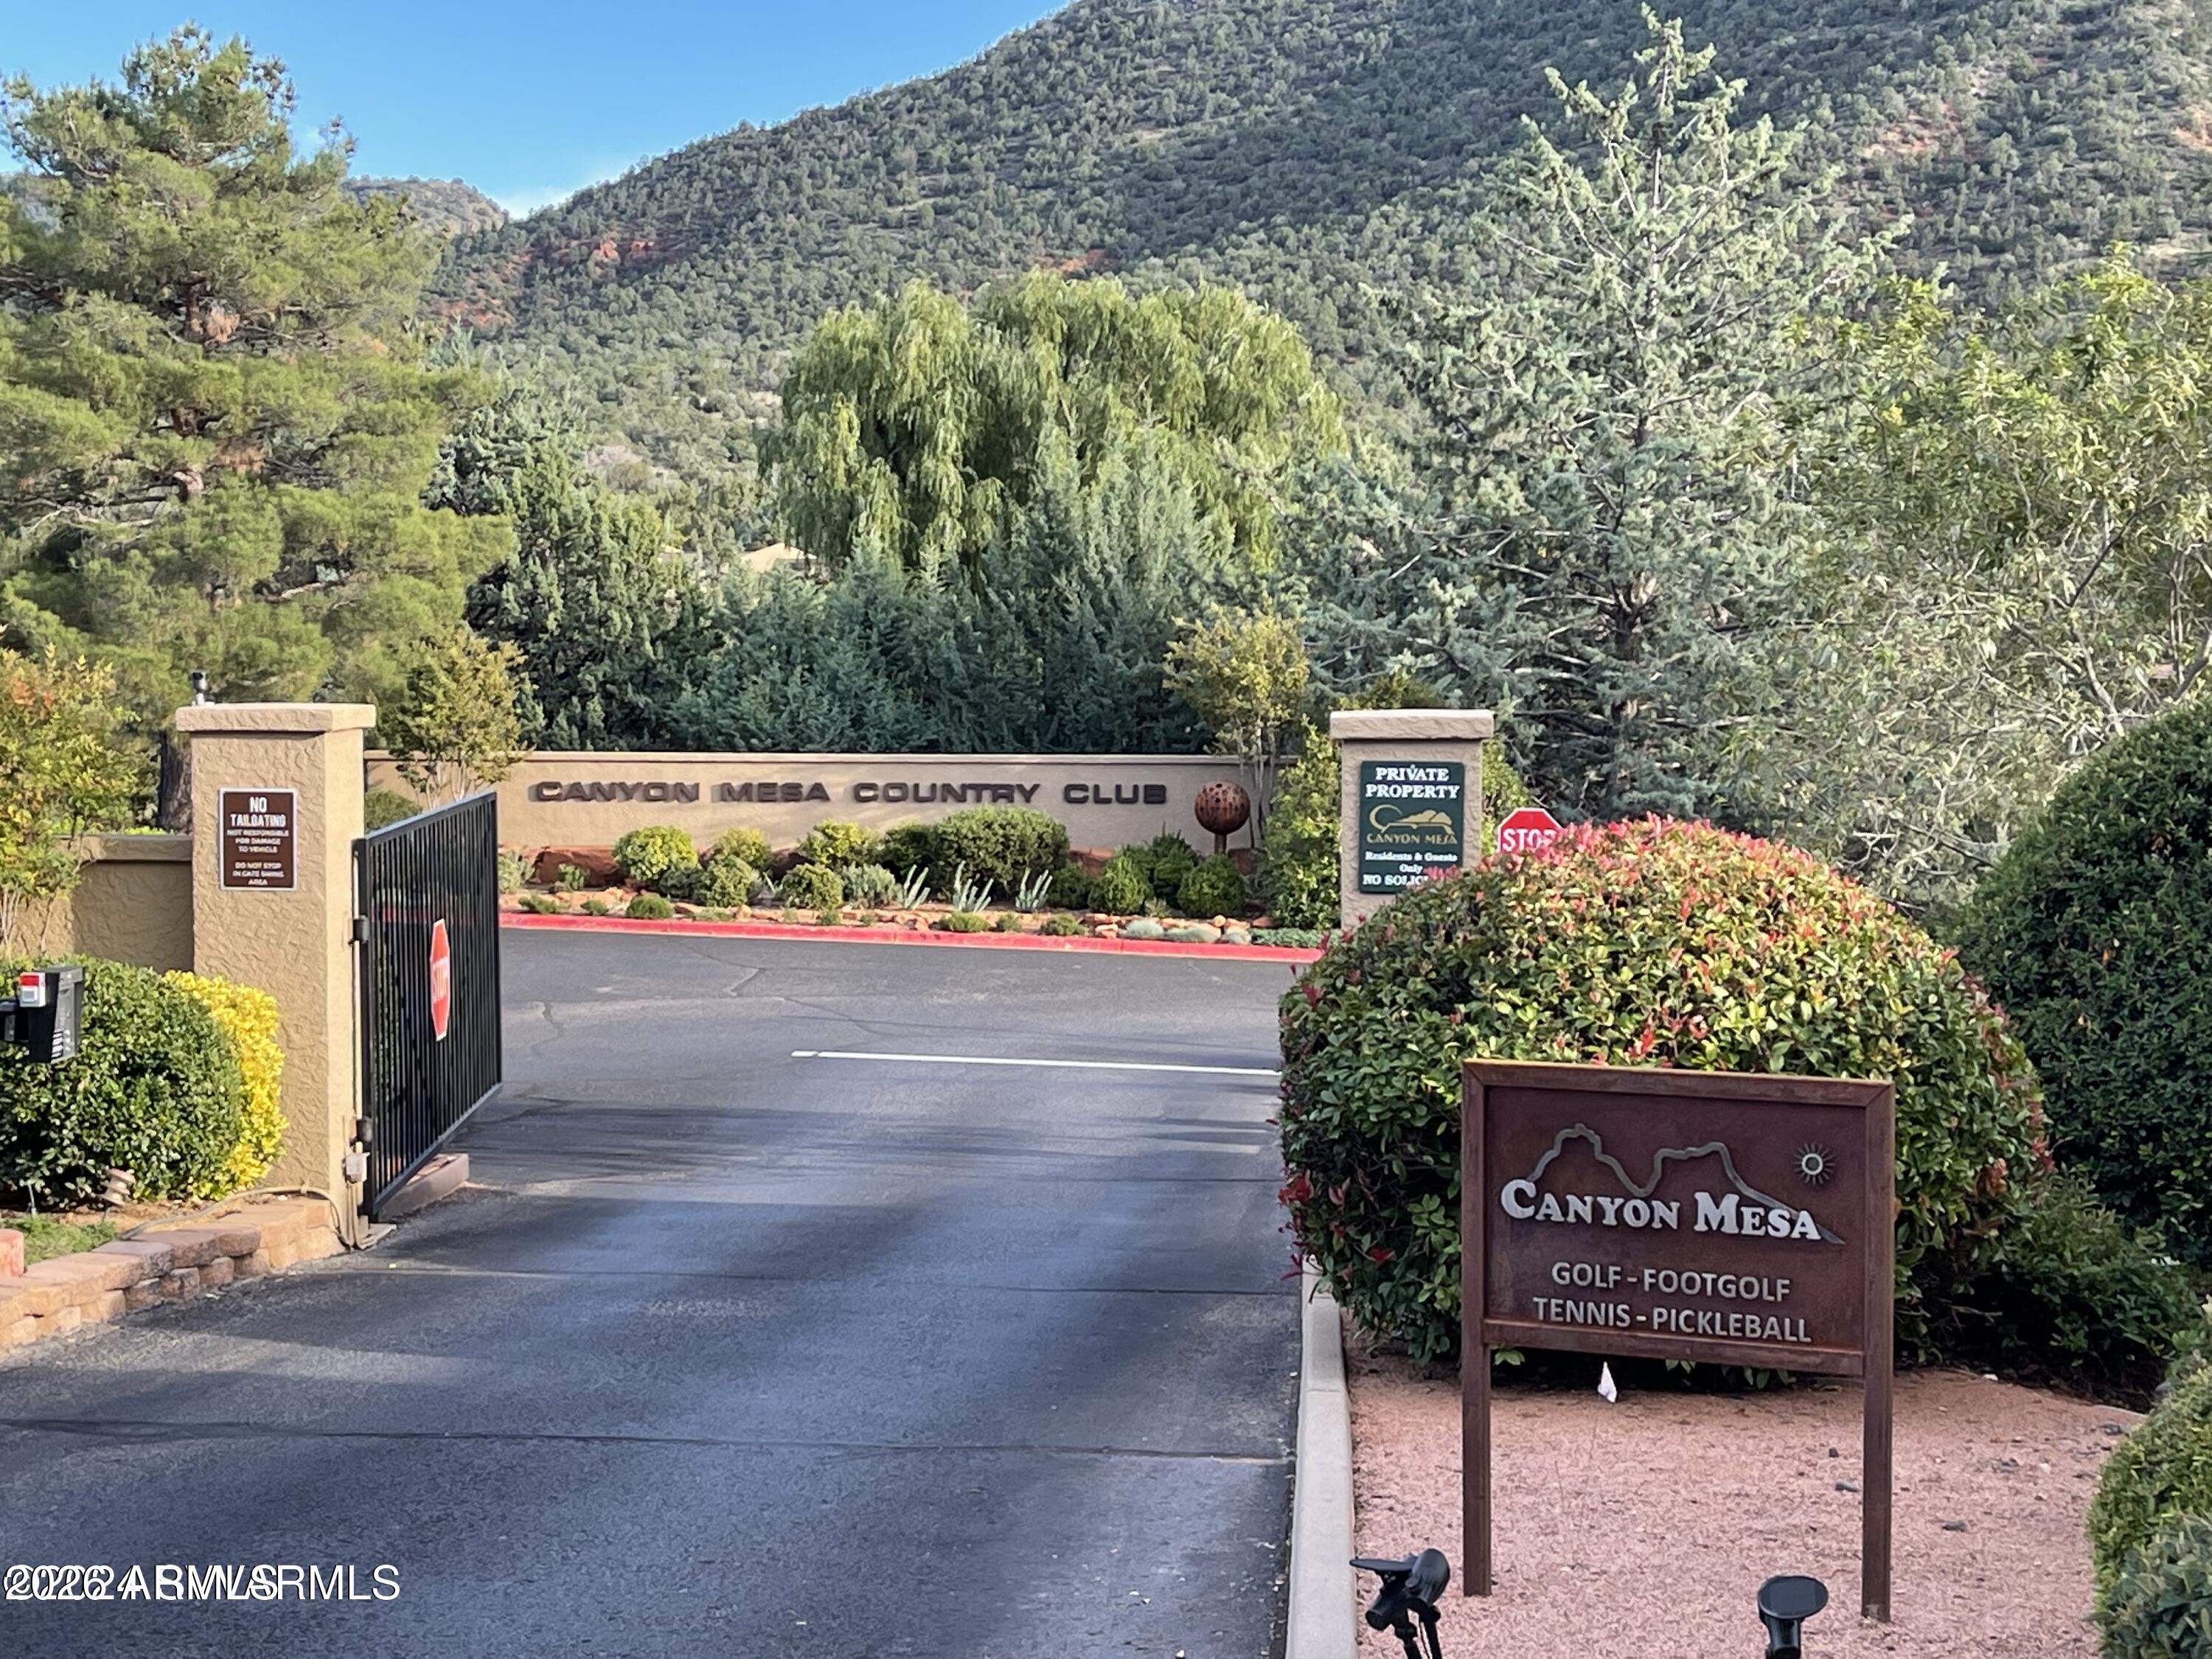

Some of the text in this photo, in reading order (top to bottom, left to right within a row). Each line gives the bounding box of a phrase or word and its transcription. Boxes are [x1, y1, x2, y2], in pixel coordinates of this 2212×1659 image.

[1375, 765, 1450, 782] PRIVATE
[535, 782, 1167, 804] CANYON MESA COUNTRY CLUB
[1365, 784, 1460, 799] PROPERTY
[249, 796, 268, 813] NO
[1366, 833, 1458, 844] CANYON MESA
[1365, 851, 1458, 862] Residents & Guests
[1399, 863, 1424, 874] Only
[1363, 874, 1382, 885] NO
[1500, 1179, 1821, 1240] CANYON MESA
